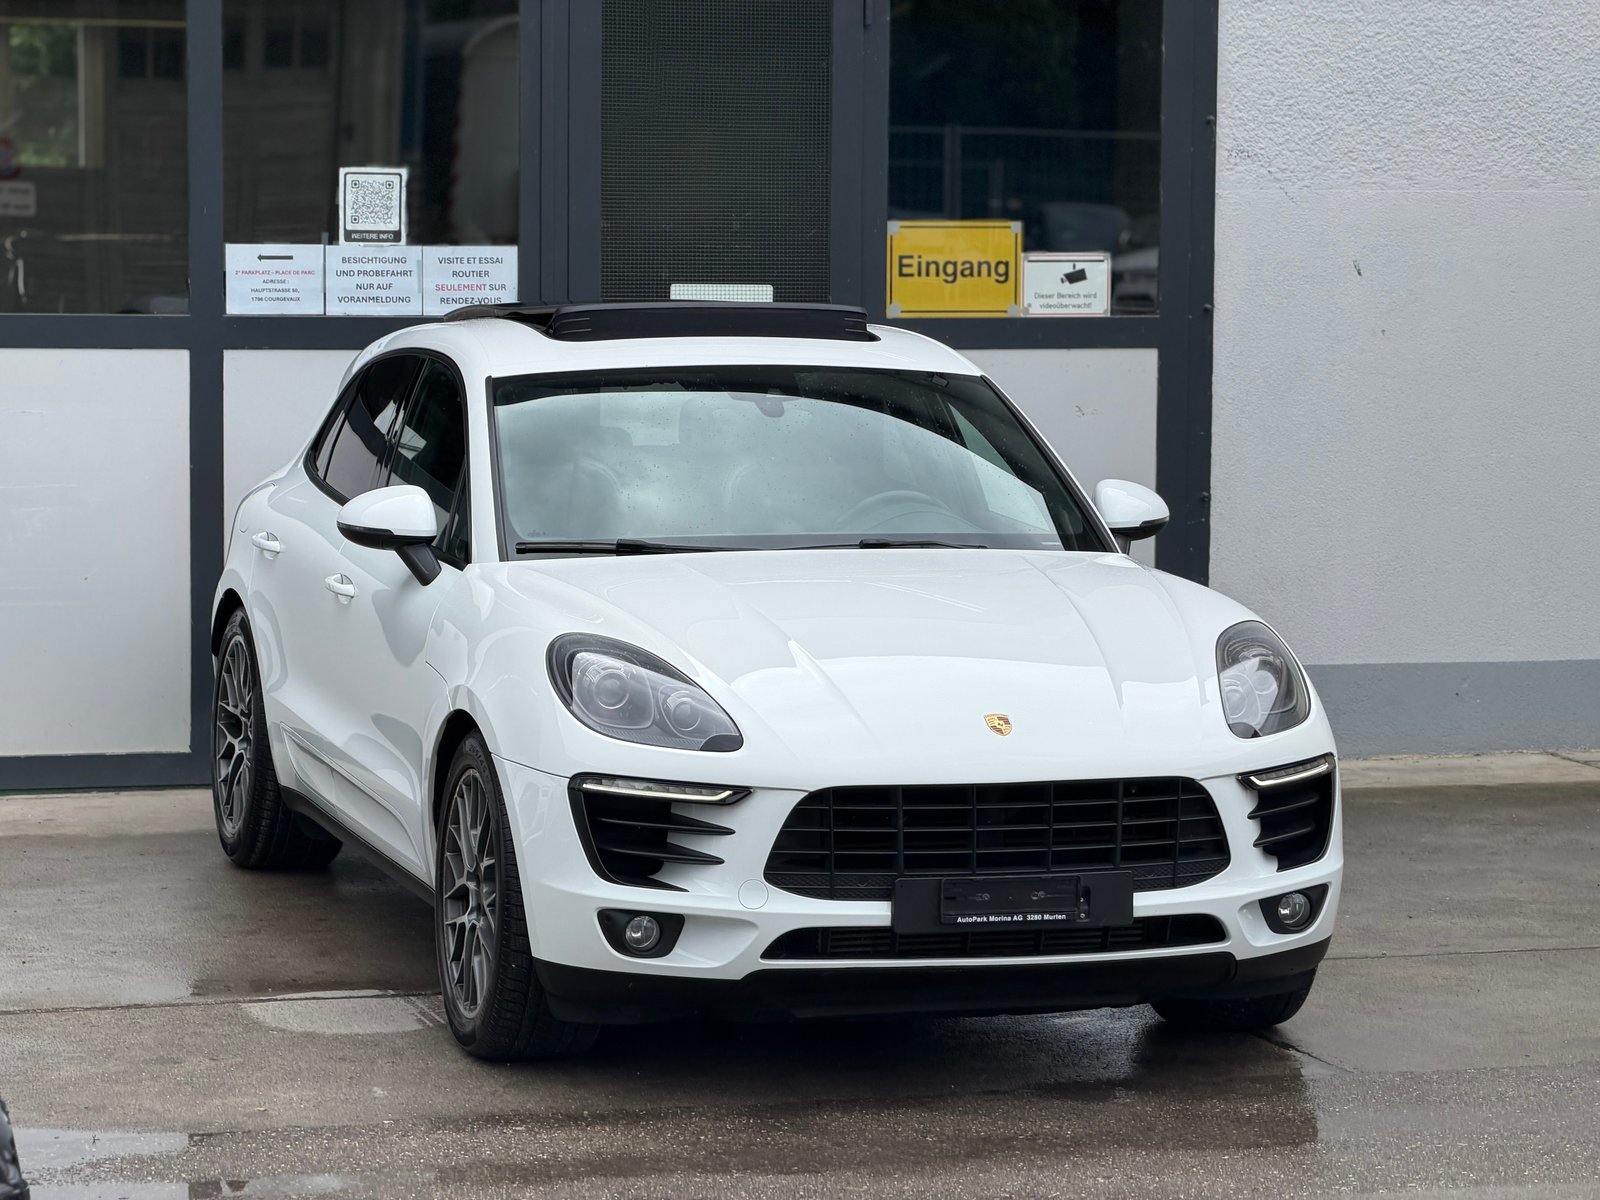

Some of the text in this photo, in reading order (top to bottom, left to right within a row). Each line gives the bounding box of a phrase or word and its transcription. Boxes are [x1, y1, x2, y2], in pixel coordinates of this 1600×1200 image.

[341, 256, 407, 264] BESICHTIGUNG
[898, 254, 1010, 284] Eingang
[452, 270, 490, 278] ROUTIER
